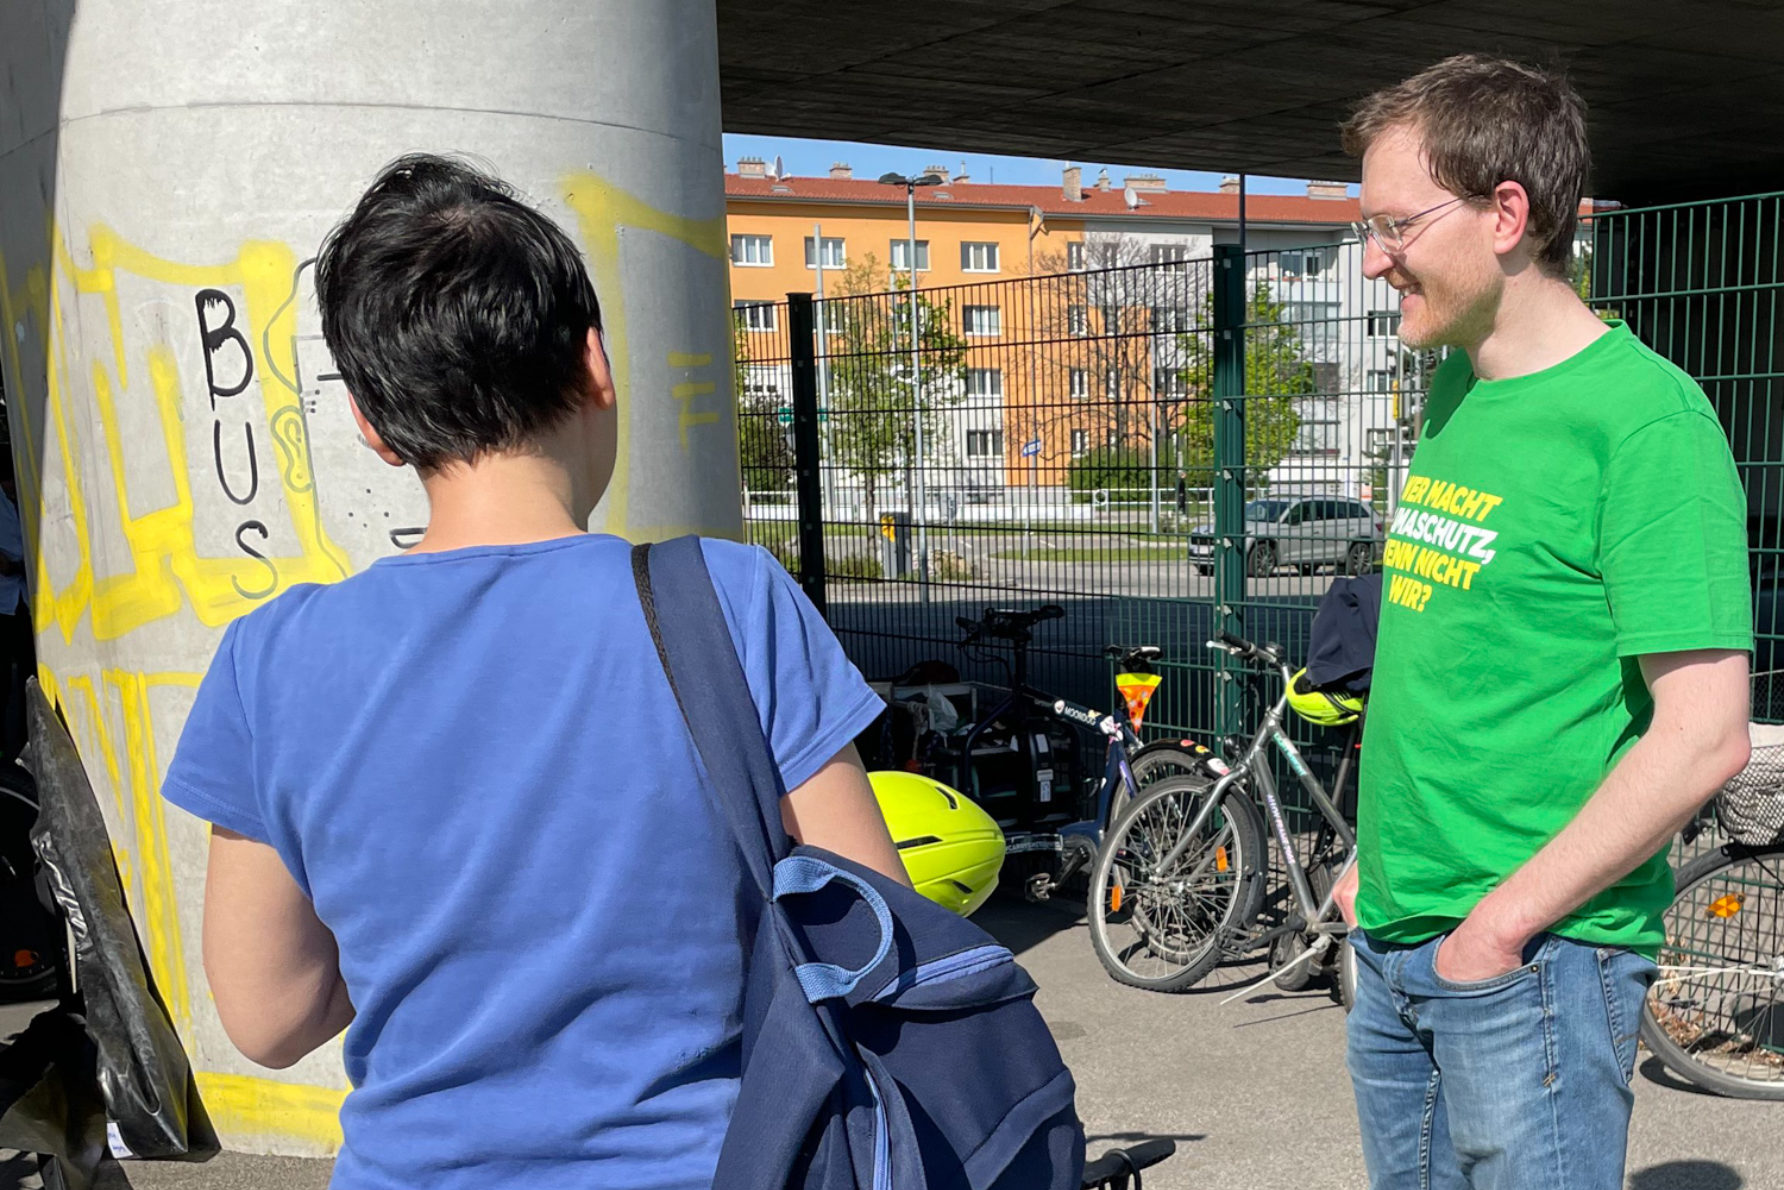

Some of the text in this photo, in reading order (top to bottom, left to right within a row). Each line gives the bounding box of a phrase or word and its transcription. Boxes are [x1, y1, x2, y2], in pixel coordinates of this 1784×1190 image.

[195, 288, 279, 600] BUS
[1424, 479, 1503, 522] MACHT
[1390, 506, 1498, 565] MASCHUTZ,
[1383, 538, 1481, 590] ENN NICHT
[1388, 574, 1433, 613] WIR?
